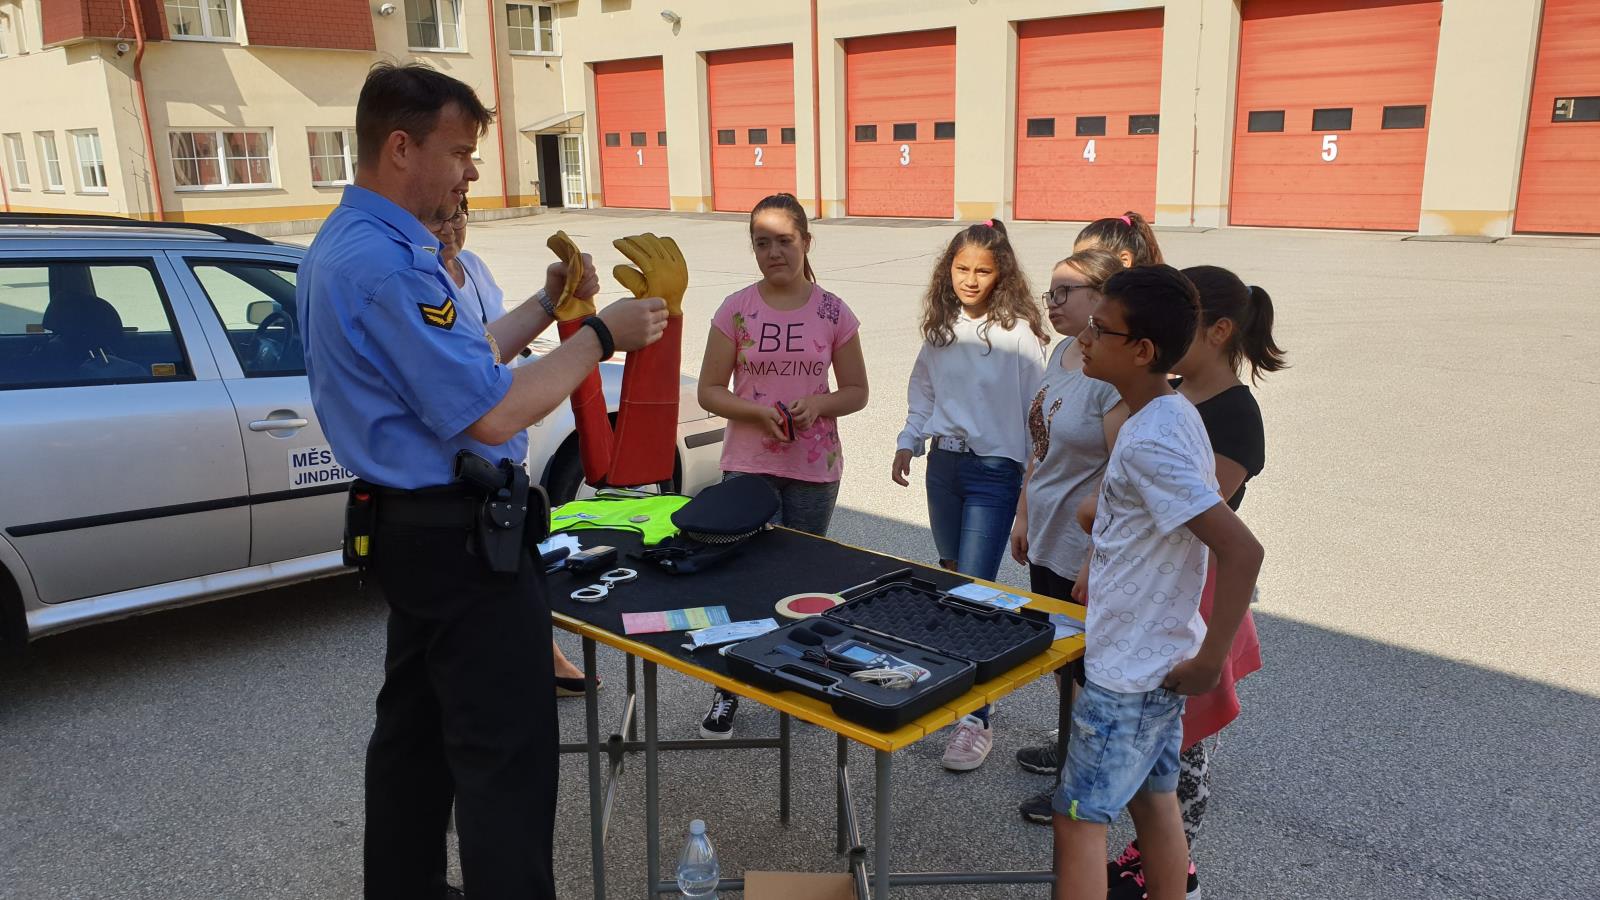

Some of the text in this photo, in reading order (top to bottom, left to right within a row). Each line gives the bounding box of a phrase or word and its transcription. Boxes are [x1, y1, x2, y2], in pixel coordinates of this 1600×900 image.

[636, 149, 643, 166] 1
[754, 147, 763, 166] 2
[900, 143, 910, 166] 3
[1083, 139, 1096, 163] 4
[1321, 134, 1338, 162] 5
[758, 322, 804, 353] BE
[743, 360, 824, 377] AMAZING
